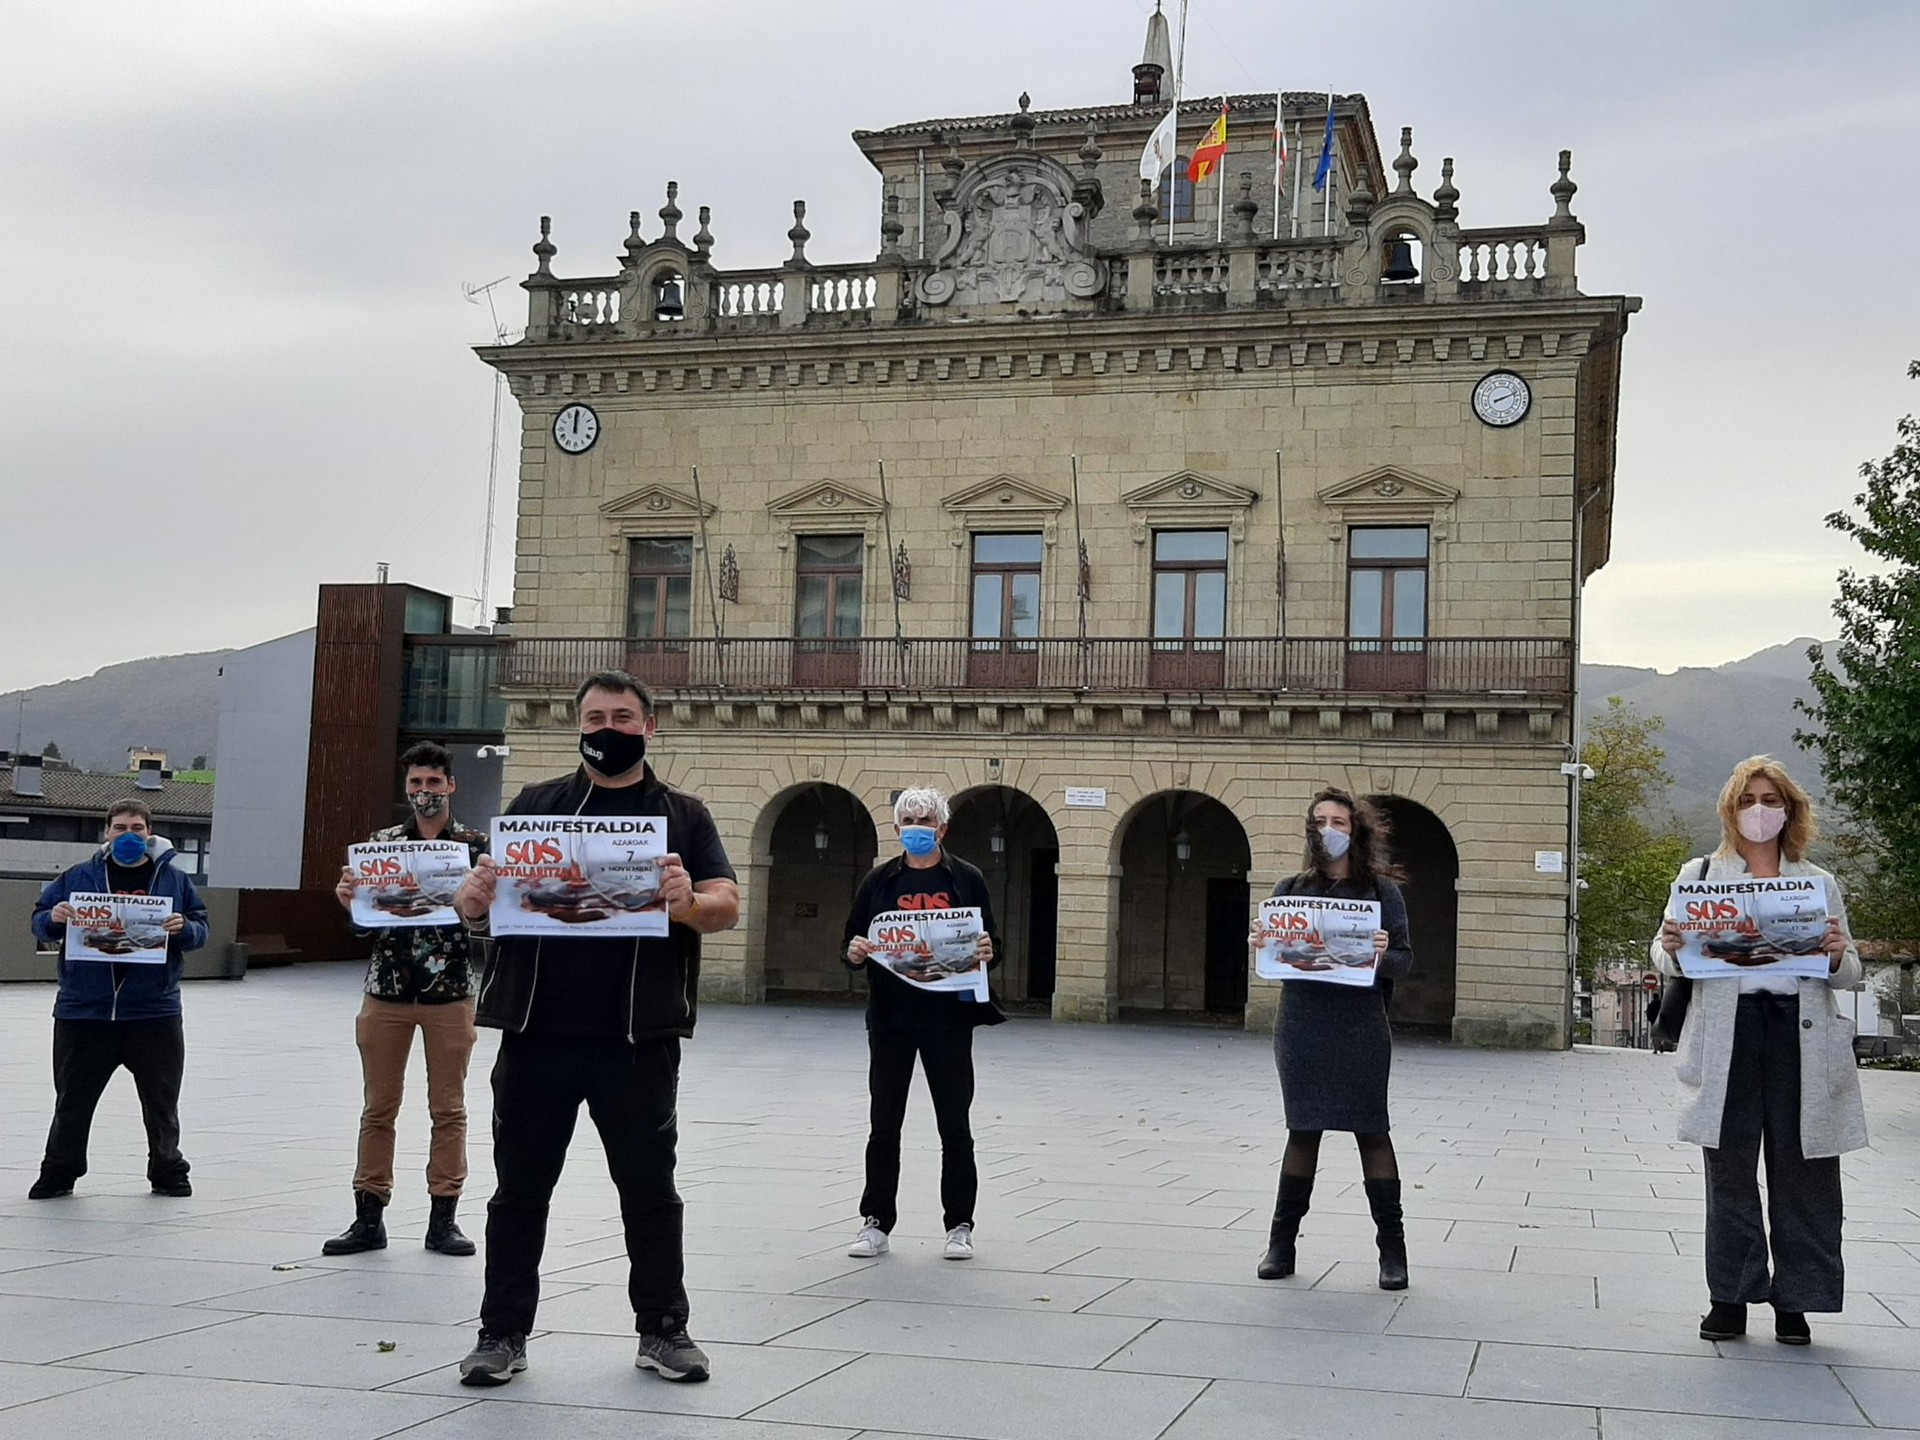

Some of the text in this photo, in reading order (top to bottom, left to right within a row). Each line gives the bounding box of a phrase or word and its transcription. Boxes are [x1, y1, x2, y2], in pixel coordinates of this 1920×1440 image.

[500, 820, 656, 834] MANIFESTALDIA
[354, 842, 462, 855] MANIFESTALDIA
[505, 837, 563, 865] SOS
[626, 850, 634, 862] 7
[360, 856, 402, 876] SOS
[445, 862, 450, 871] 7
[1678, 881, 1815, 895] MANIFESTALDIA
[75, 895, 167, 906] MANIFESTALDIA
[897, 891, 951, 910] SOS
[1264, 899, 1374, 913] MANIFESTALDIA
[76, 904, 113, 920] SOS
[1685, 898, 1739, 921] SOS
[1793, 904, 1800, 915] 7
[873, 910, 974, 925] MANIFESTALDIA
[1268, 911, 1308, 931] SOS
[878, 924, 916, 944] SOS
[956, 929, 961, 938] 7
[1352, 923, 1358, 931] 7
